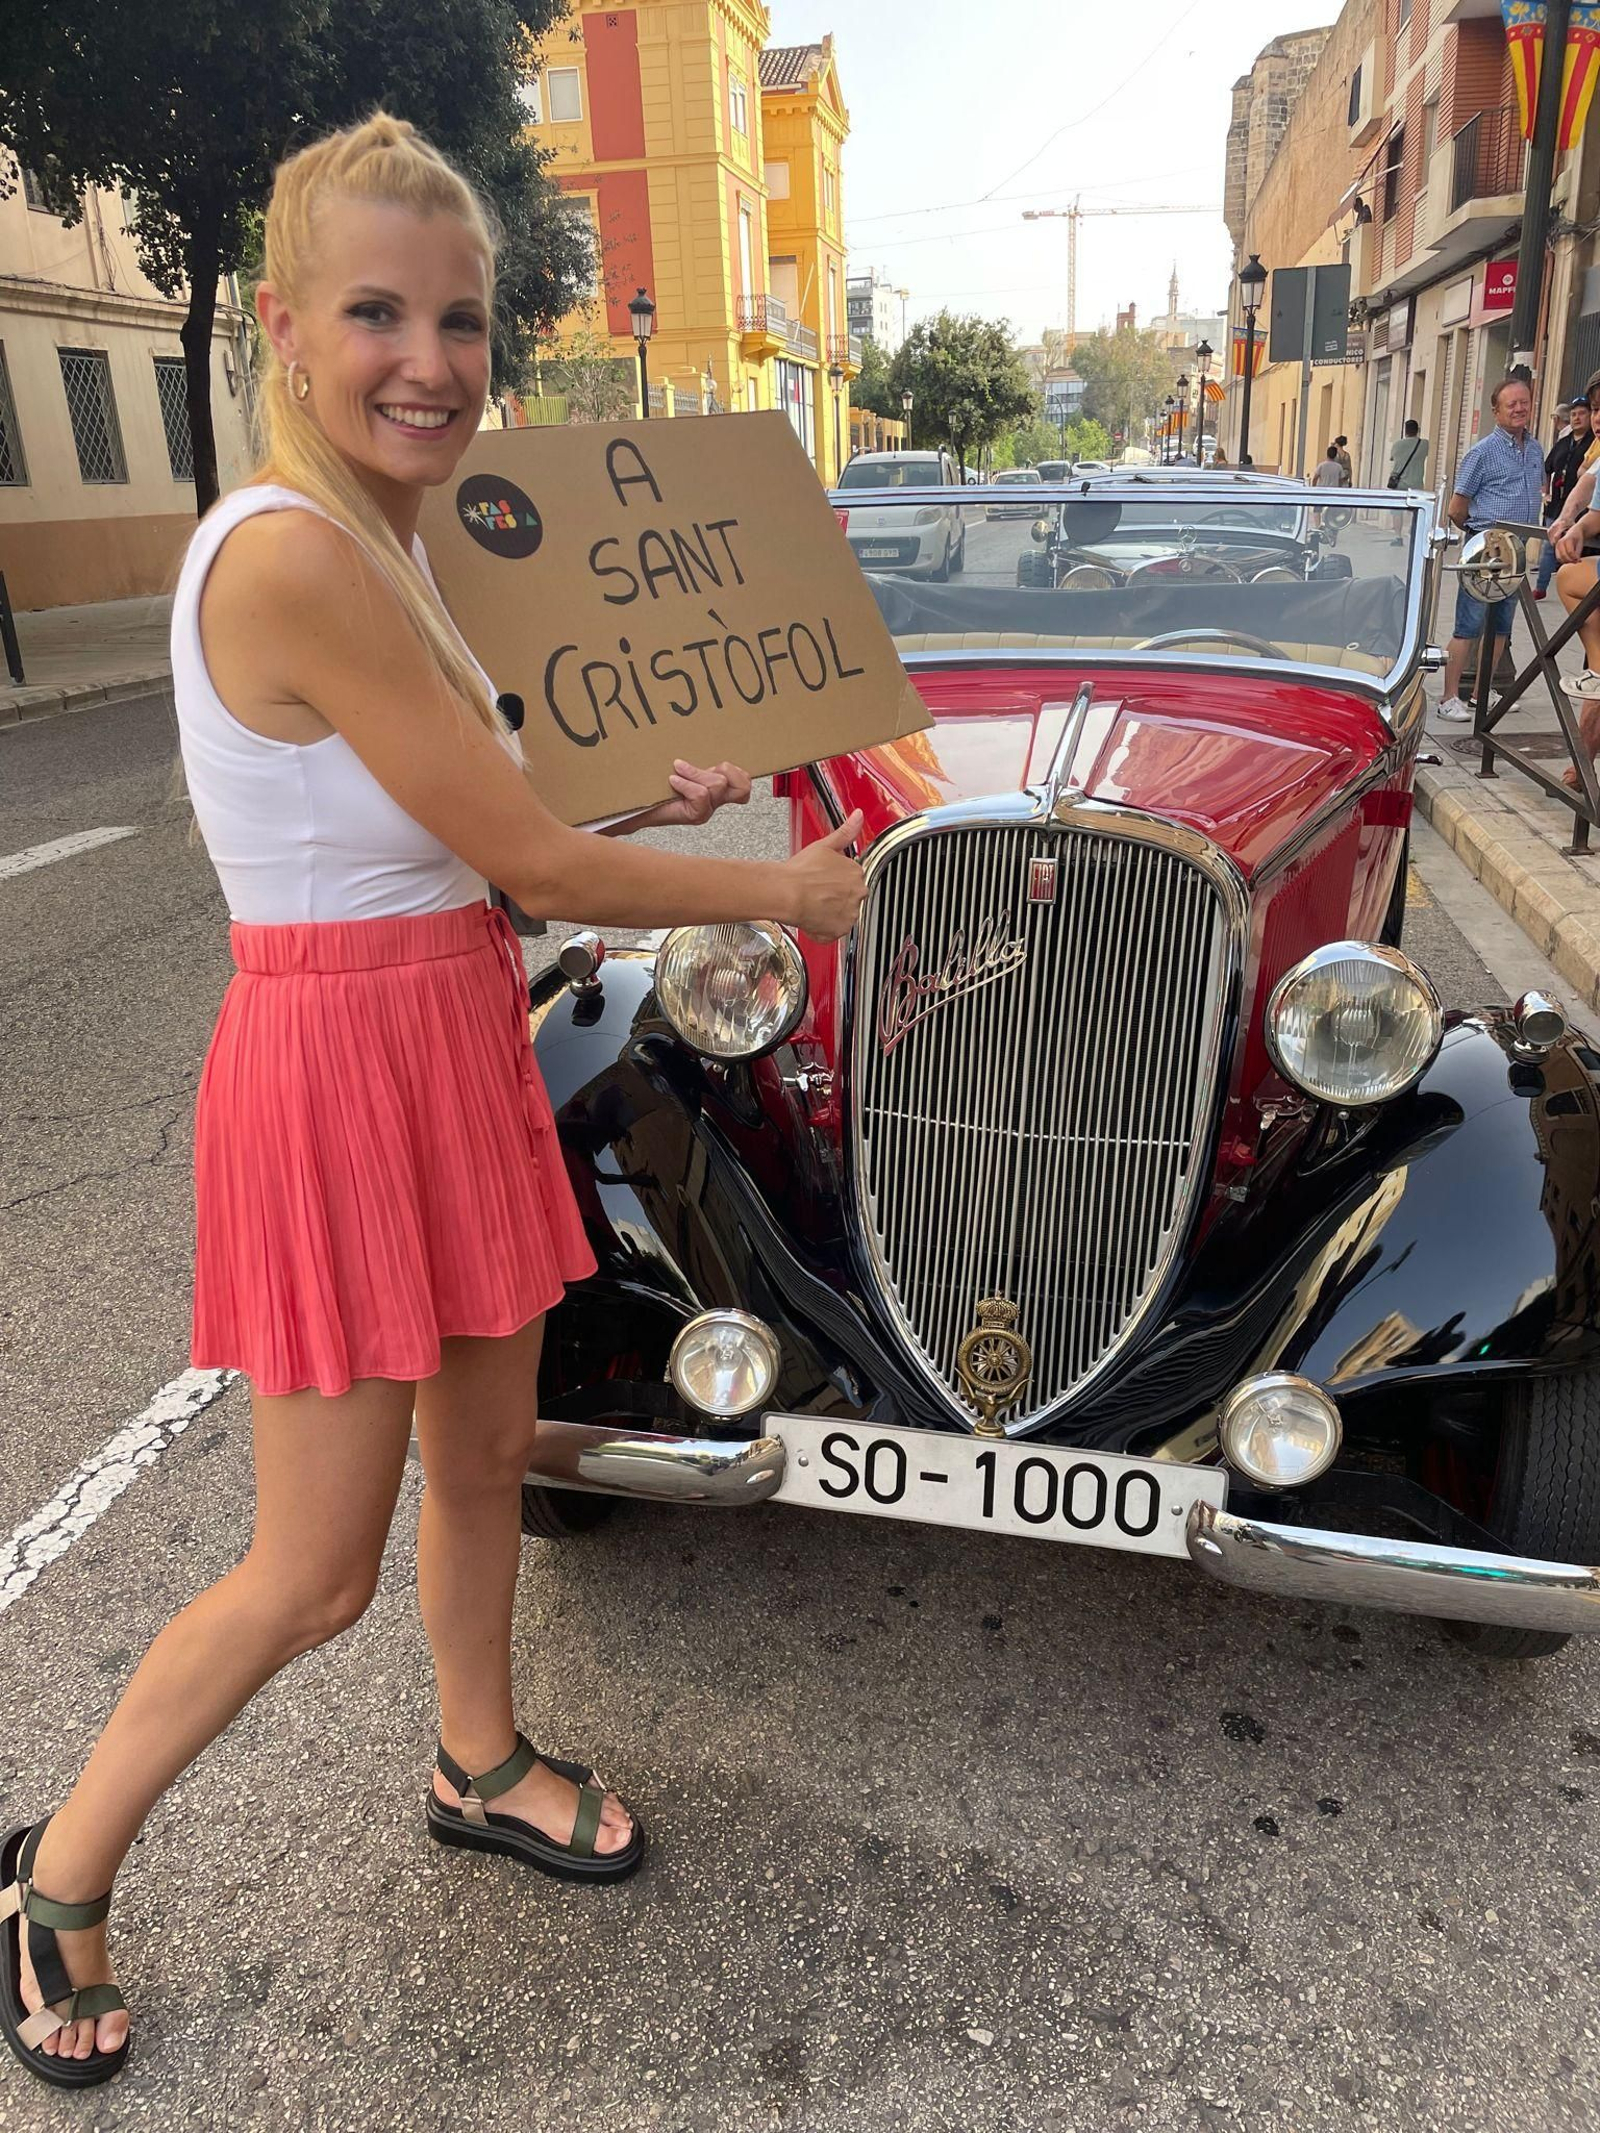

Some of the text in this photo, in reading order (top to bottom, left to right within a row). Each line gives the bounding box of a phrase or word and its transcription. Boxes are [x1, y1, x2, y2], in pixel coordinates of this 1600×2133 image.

[1314, 356, 1363, 366] CONDUCTORES
[605, 437, 664, 507] A
[588, 518, 745, 605] SANT
[1032, 863, 1054, 881] FIAT
